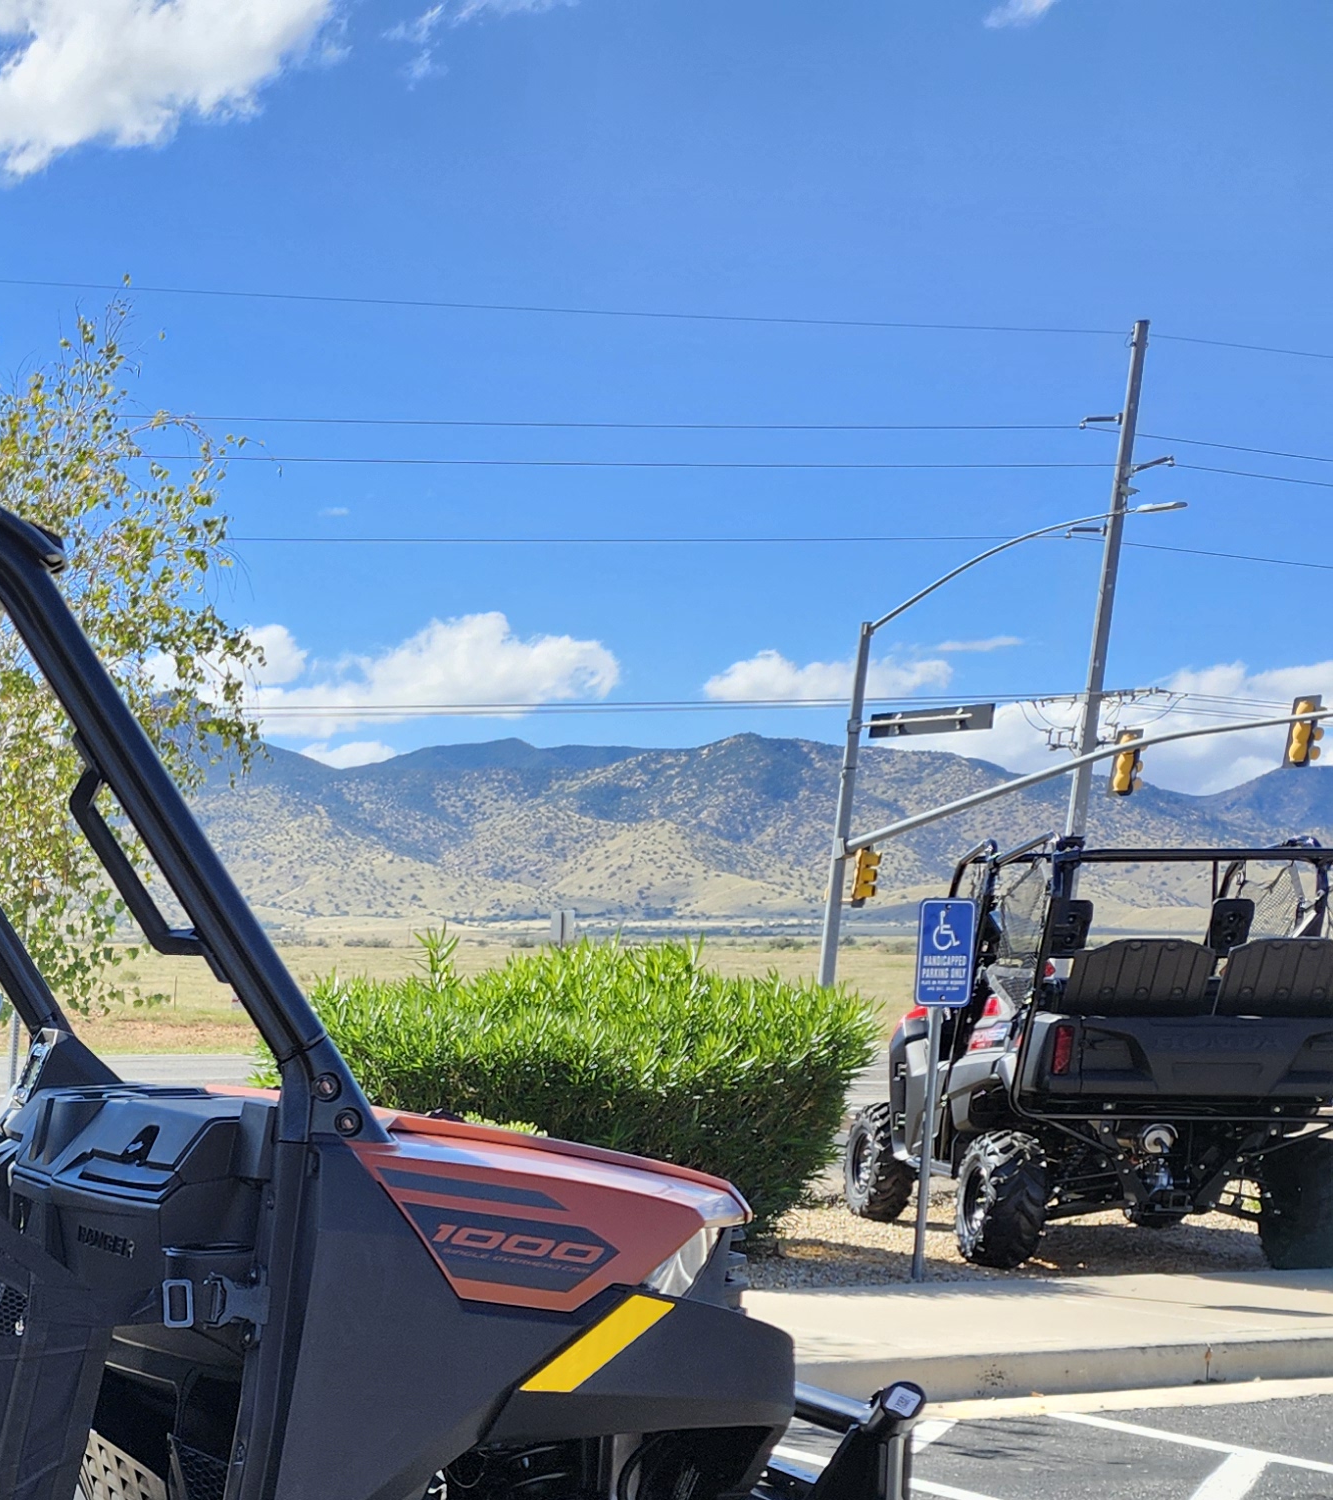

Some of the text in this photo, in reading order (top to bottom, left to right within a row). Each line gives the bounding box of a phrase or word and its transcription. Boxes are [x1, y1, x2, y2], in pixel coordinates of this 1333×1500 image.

[923, 955, 967, 966] HANDICAPPED
[921, 968, 967, 978] PARKING ONLY
[77, 1224, 135, 1259] RANGER
[432, 1223, 605, 1264] 1000
[442, 1247, 490, 1259] SINGLE
[492, 1254, 561, 1270] OVERHEAD
